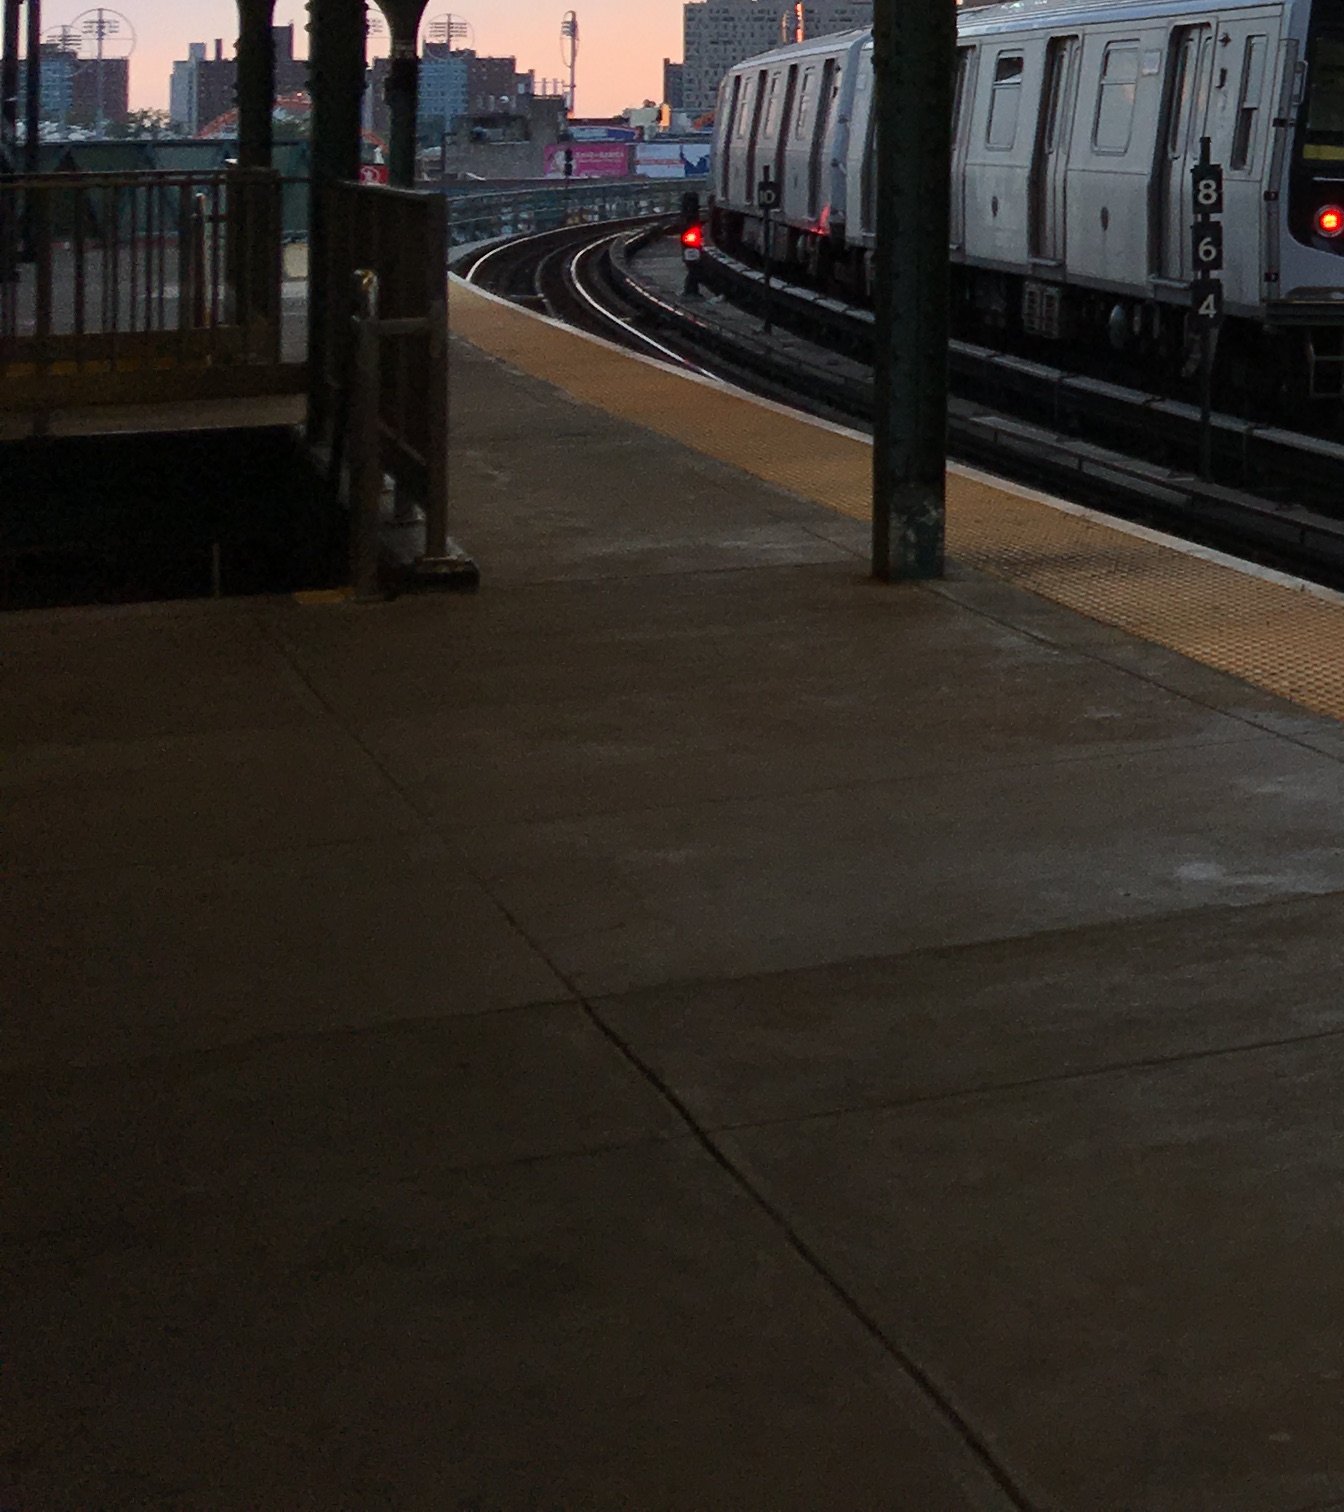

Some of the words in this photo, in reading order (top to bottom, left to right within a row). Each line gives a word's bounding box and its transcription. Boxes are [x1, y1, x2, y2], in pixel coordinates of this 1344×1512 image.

[759, 189, 776, 204] 10
[1197, 179, 1218, 205] 8
[1198, 236, 1217, 262] 6
[1198, 293, 1217, 319] 4
